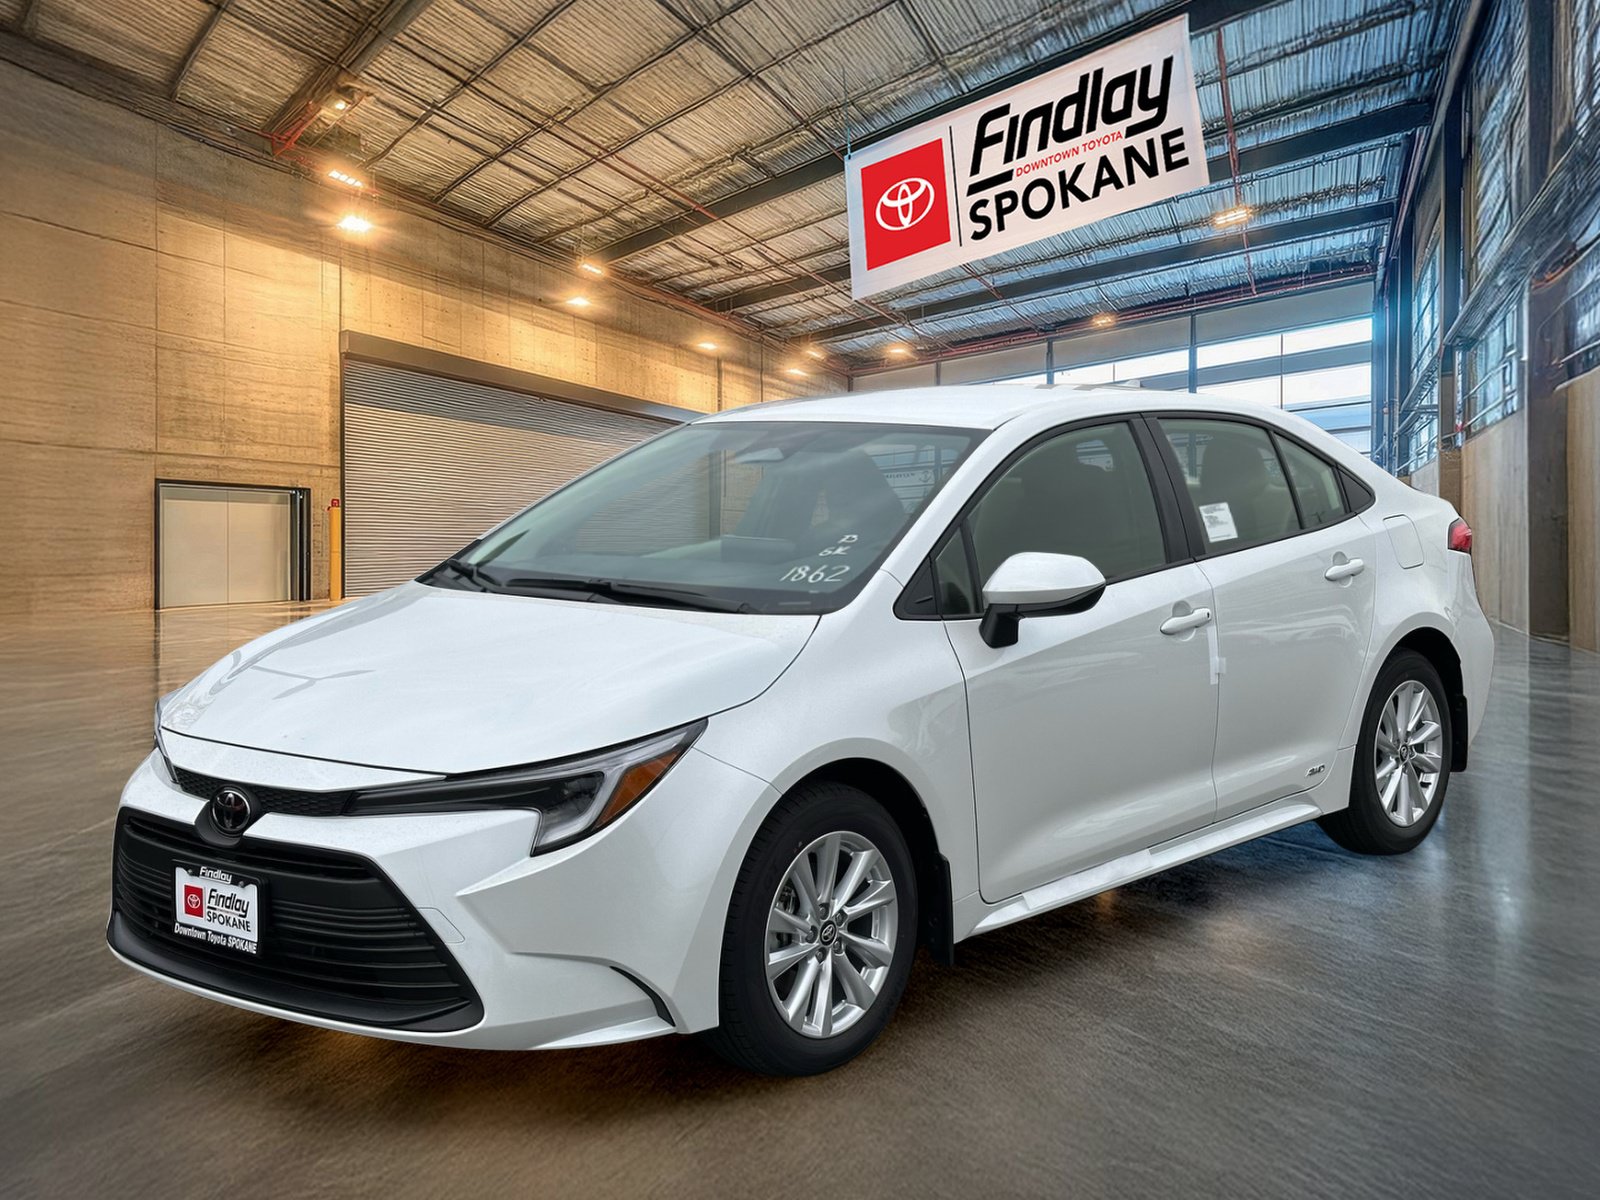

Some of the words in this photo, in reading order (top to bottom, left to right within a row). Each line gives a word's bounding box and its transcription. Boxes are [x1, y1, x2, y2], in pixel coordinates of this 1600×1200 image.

[968, 56, 1173, 181] Findlay
[1015, 147, 1079, 177] DOWNTOWN
[1082, 130, 1123, 153] TOYOTA
[969, 127, 1190, 241] SPOKANE
[779, 564, 850, 583] 1862
[199, 866, 232, 884] Findlay
[207, 888, 249, 918] Findlay
[206, 911, 251, 932] SPOKANE
[174, 922, 207, 940] Downtown
[207, 931, 227, 946] Toyota
[227, 936, 257, 954] SPOKANE
